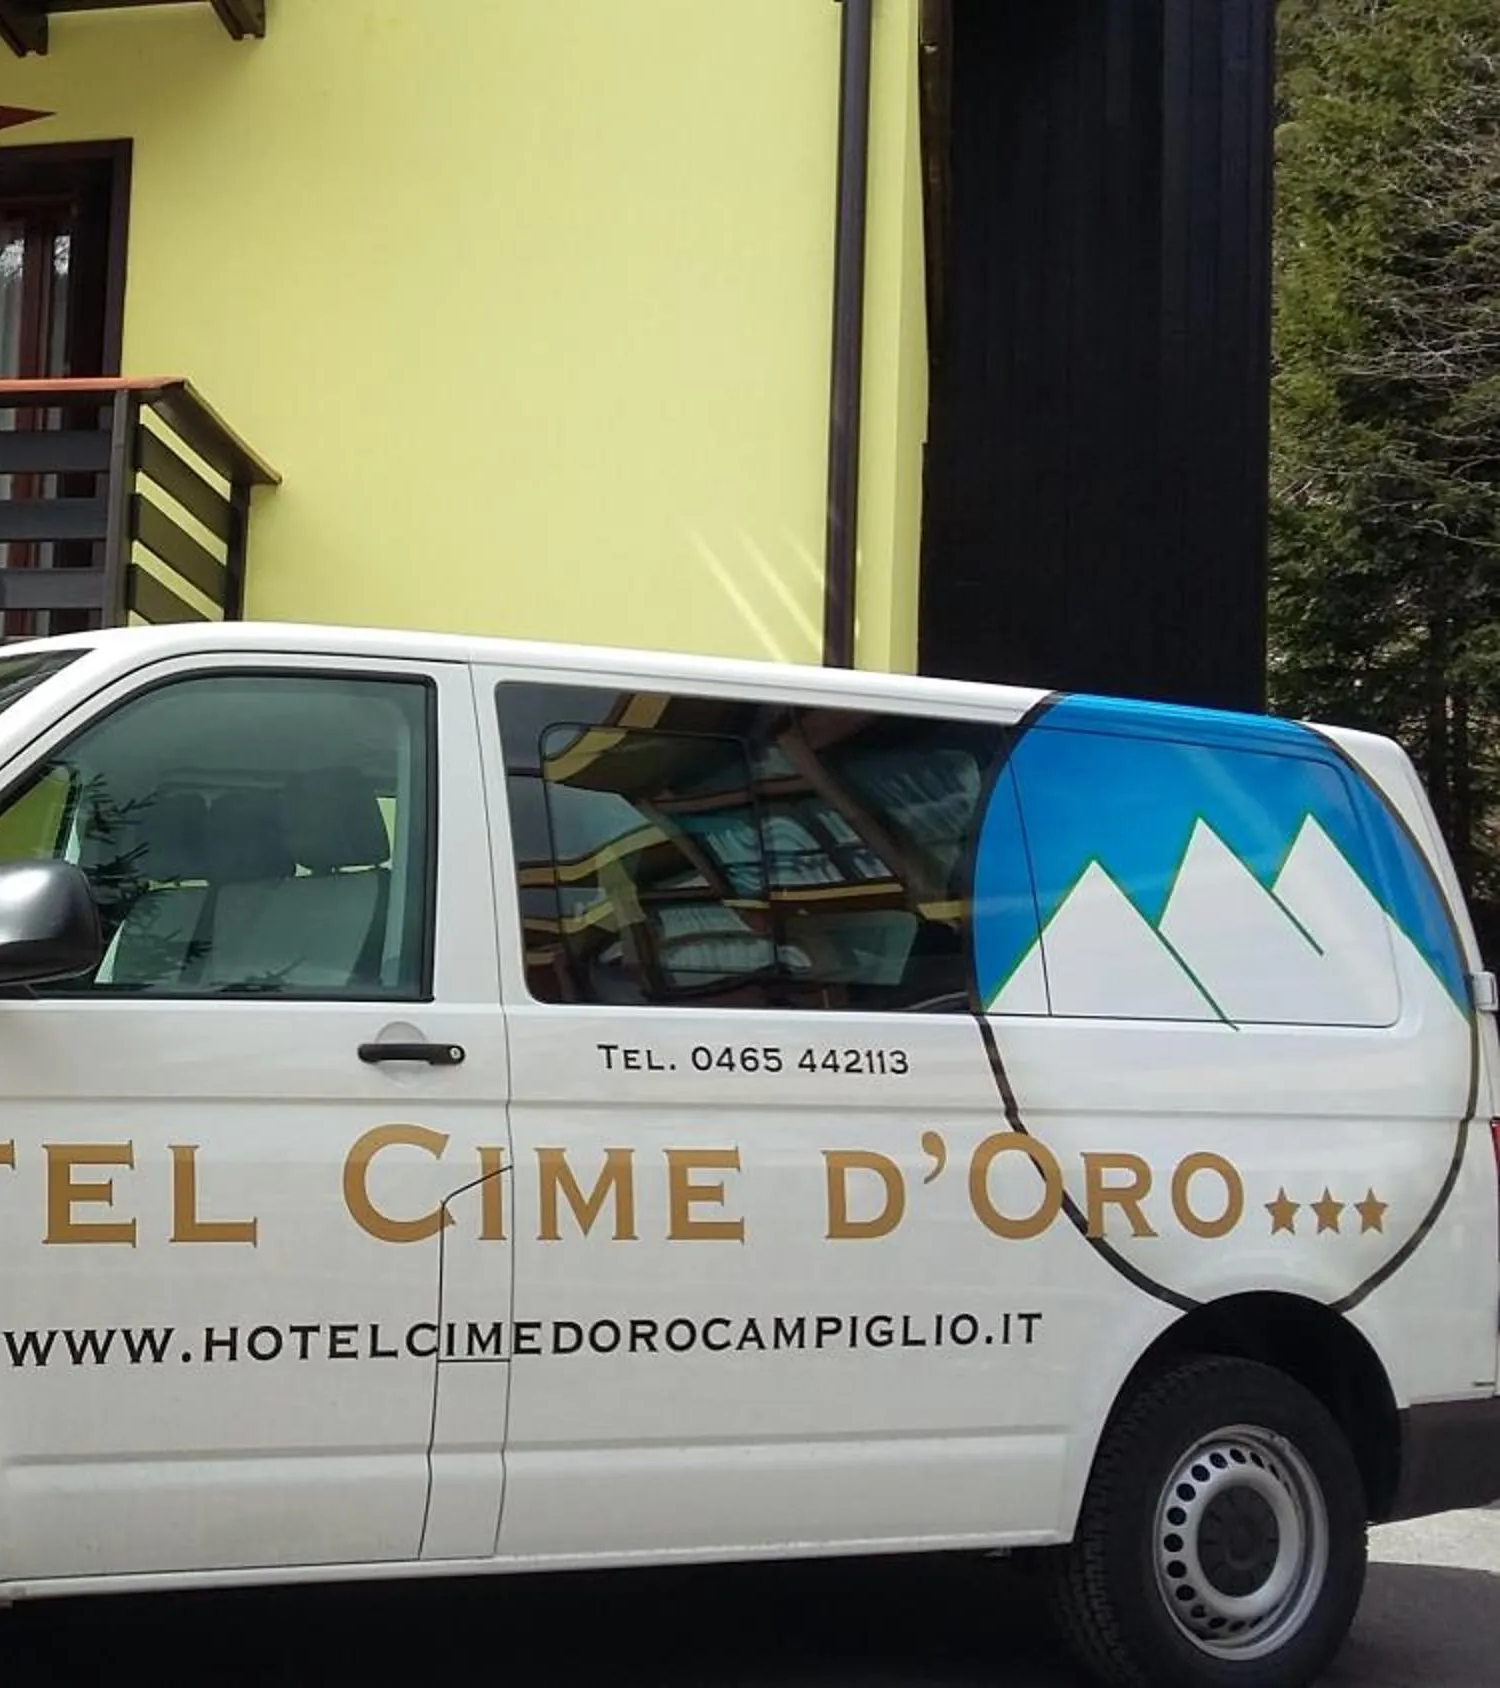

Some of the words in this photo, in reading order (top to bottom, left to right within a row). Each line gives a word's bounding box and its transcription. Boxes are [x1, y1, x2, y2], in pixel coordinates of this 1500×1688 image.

[597, 1044, 677, 1071] TEL.
[691, 1046, 783, 1073] 0465
[798, 1048, 909, 1075] 442113
[343, 1123, 746, 1243] CIME
[821, 1130, 1244, 1239] D'ORO
[2, 1312, 1043, 1367] WWW.HOTELCIMEDOROCAMPIGLIO.IT
